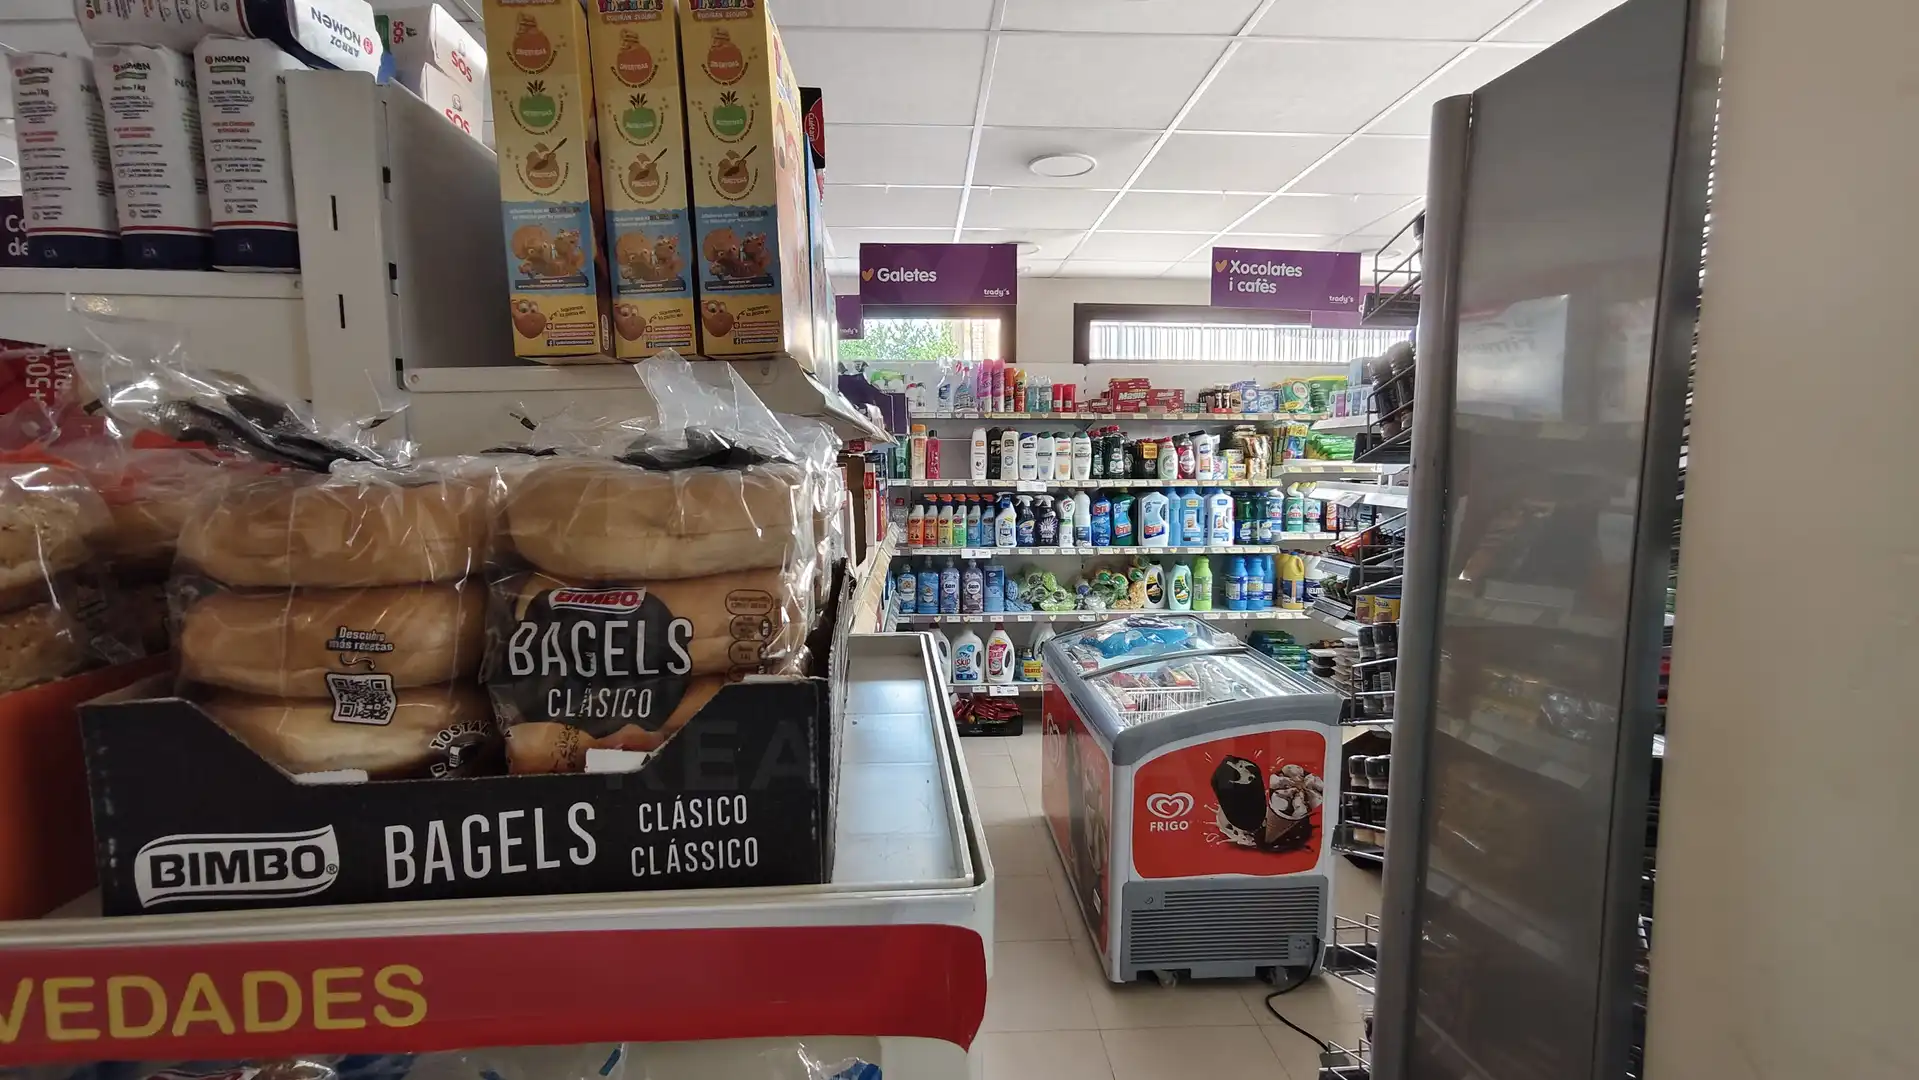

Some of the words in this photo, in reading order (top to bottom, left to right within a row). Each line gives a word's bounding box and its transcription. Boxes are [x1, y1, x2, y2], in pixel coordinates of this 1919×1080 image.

[393, 20, 405, 44] SOS
[329, 34, 360, 58] ARROZ
[451, 50, 473, 82] SOS
[877, 267, 937, 282] Galetes
[1229, 259, 1303, 278] Xocolates
[983, 288, 1010, 297] trady's
[1228, 277, 1234, 291] i
[1237, 278, 1277, 294] cafès
[54, 351, 73, 399] RATI
[554, 590, 642, 608] BIMBO
[329, 638, 353, 650] más
[354, 639, 395, 652] recetas
[339, 626, 386, 642] Descubre
[508, 618, 694, 678] BAGELS
[547, 682, 652, 719] CLÁSICO
[638, 794, 748, 833] CLÁSICO
[1150, 820, 1189, 832] FRIGO
[149, 844, 326, 889] BIMBO
[384, 801, 598, 889] BAGELS
[630, 837, 759, 878] CLÁSSICO
[0, 964, 428, 1044] VEDADES
